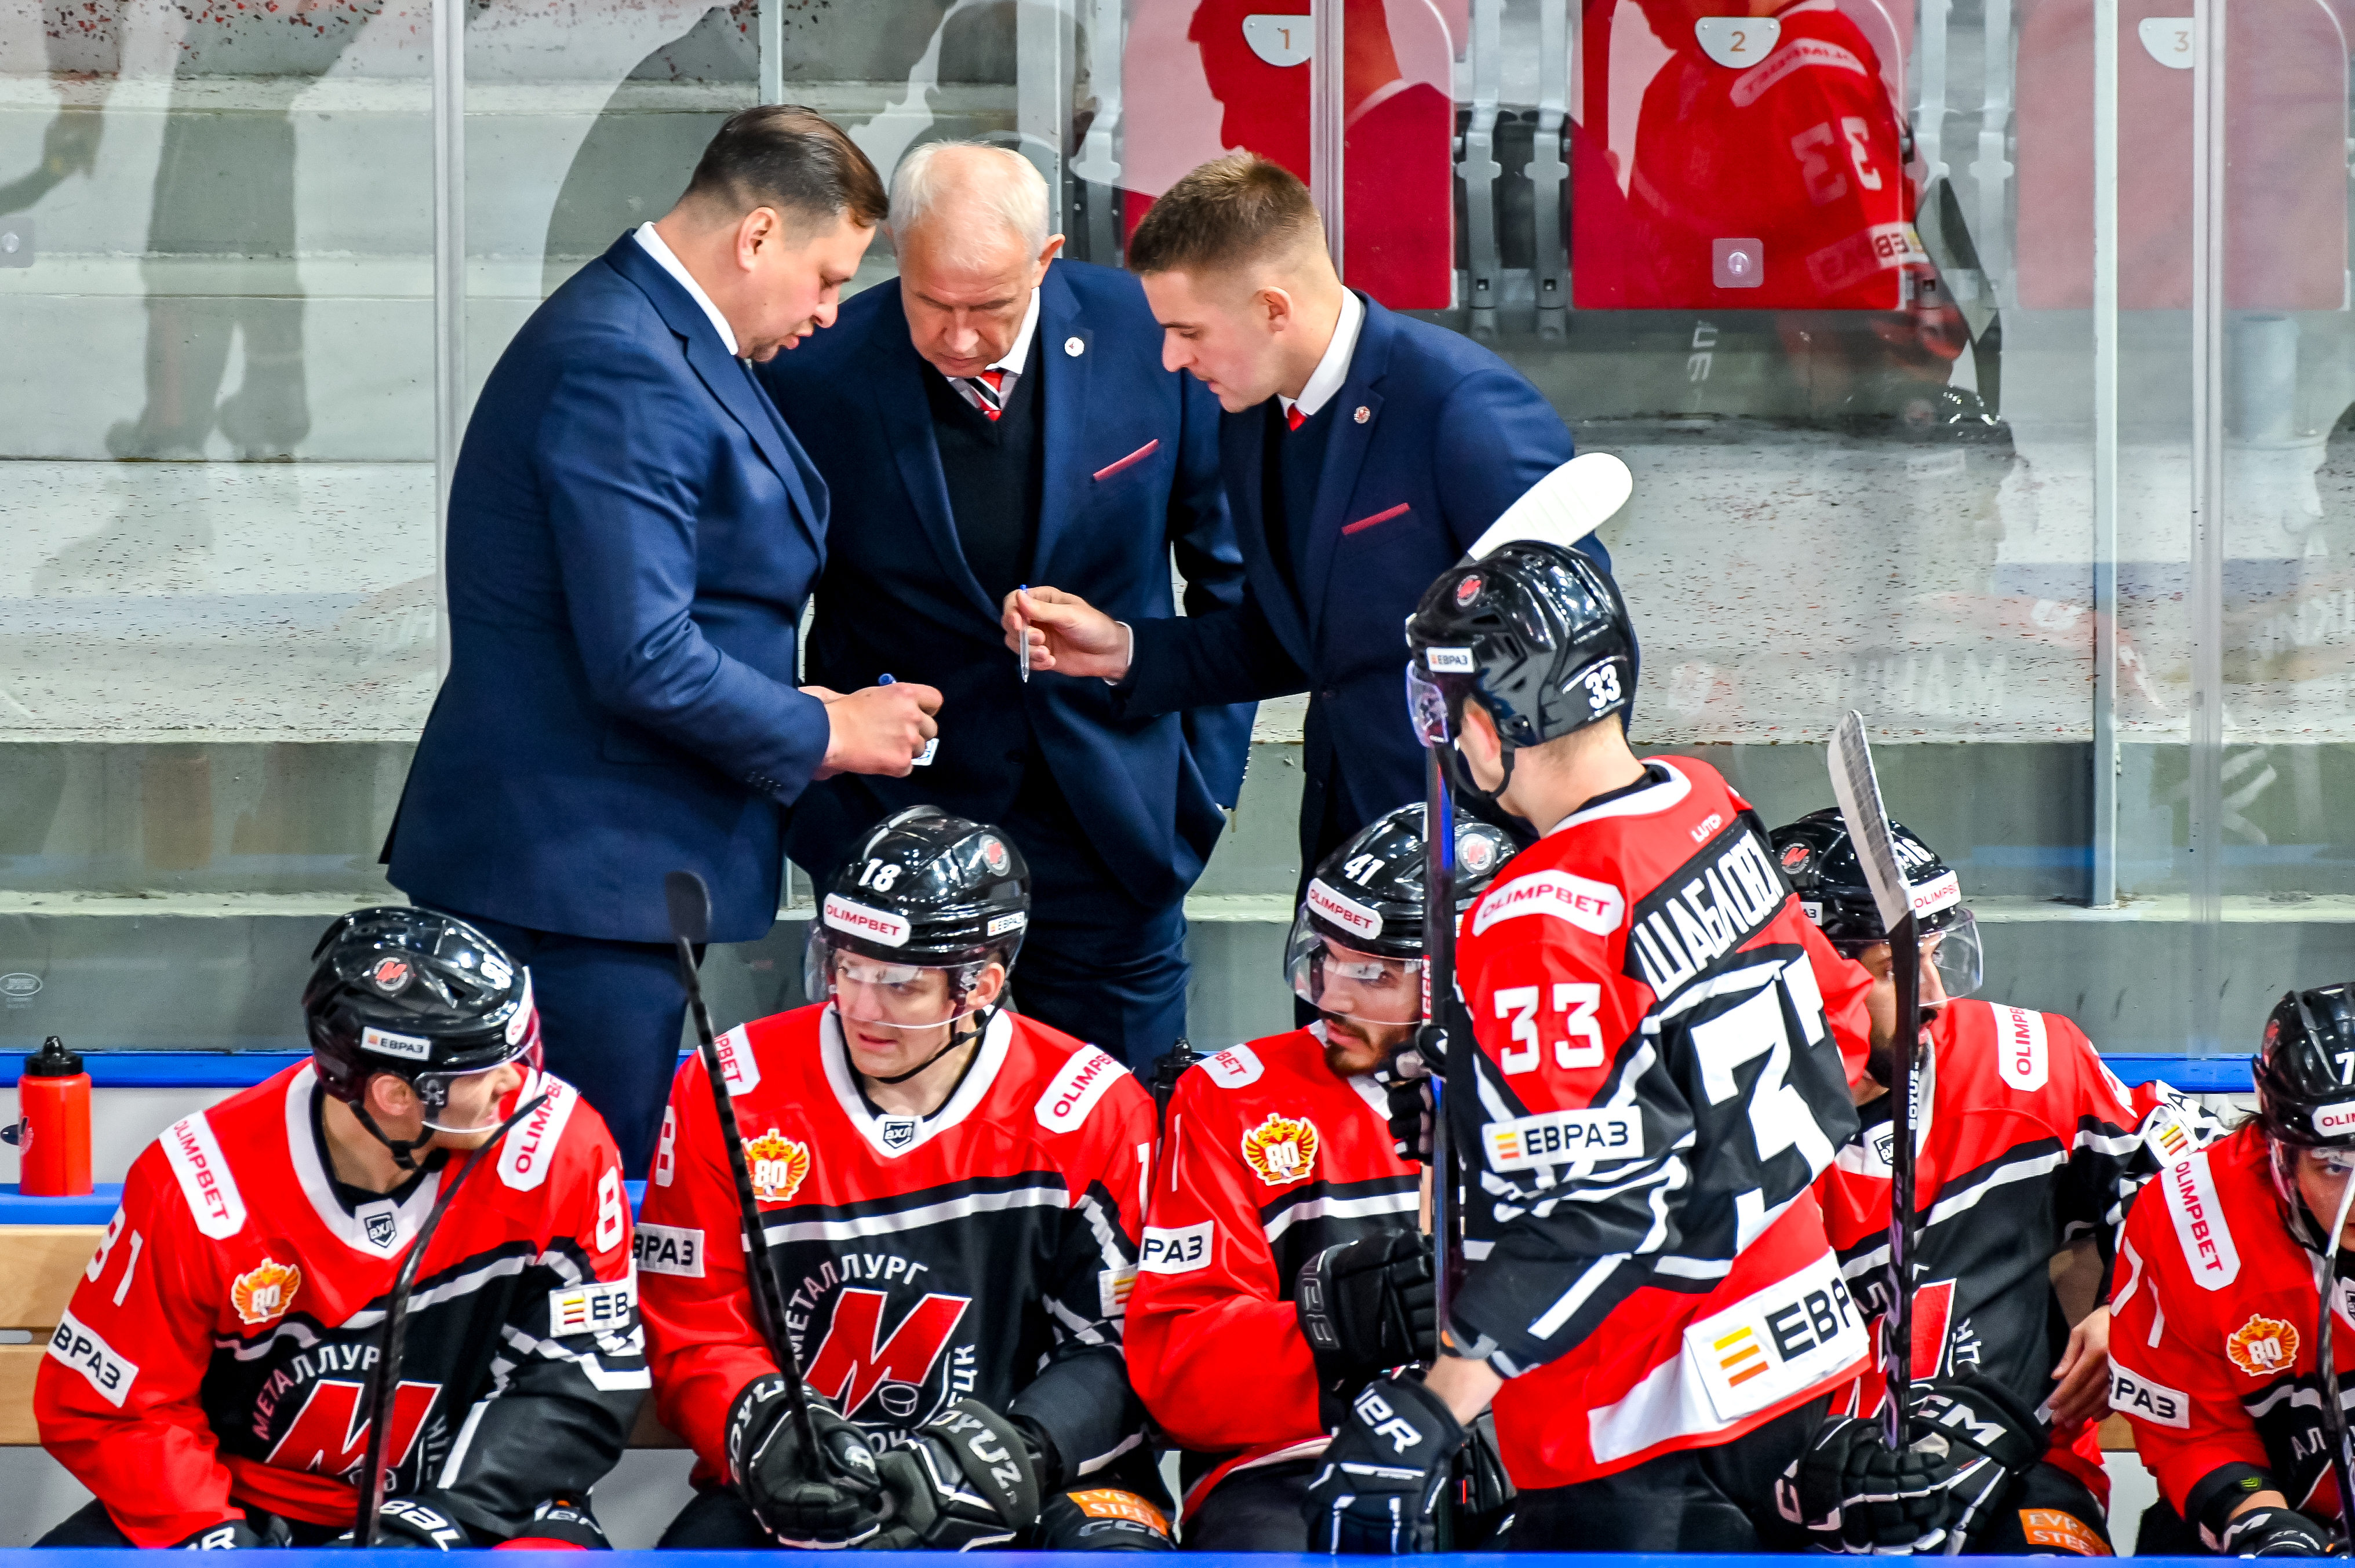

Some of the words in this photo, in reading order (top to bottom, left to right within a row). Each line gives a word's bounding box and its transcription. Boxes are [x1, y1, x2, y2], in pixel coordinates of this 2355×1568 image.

[1281, 28, 1291, 49] 1
[1730, 31, 1746, 52] 2
[2174, 31, 2189, 53] 3
[1585, 664, 1622, 709] 33
[858, 858, 902, 892] 18
[1344, 854, 1385, 886] 41
[1309, 888, 1374, 929] OLIMPBET
[1482, 884, 1611, 919] OLIMPBET
[825, 904, 901, 937] OLIMPBET
[380, 1037, 424, 1054] ЕВРАЗ
[1494, 982, 1605, 1075] 33
[2010, 1007, 2032, 1075] OLIMPB
[1053, 1052, 1117, 1117] OLIMPB
[2335, 1051, 2355, 1085] 7
[655, 1105, 676, 1187] 8
[1524, 1120, 1629, 1157] ЕВРАЗ
[174, 1120, 230, 1220] OLIMPBET
[754, 1159, 788, 1189] 80
[1265, 1142, 1301, 1173] 80
[596, 1165, 623, 1254] 8
[2174, 1161, 2225, 1272] OLIMPBET
[632, 1234, 694, 1266] ВРАЗ
[1143, 1235, 1203, 1264] РАЗ
[785, 1253, 929, 1361] МЕТАЛЛУРГ
[1766, 1276, 1852, 1363] ЕВР
[53, 1322, 121, 1390] ВРАЗ
[2247, 1336, 2283, 1365] 80
[252, 1344, 381, 1442] МЕТАЛЛУР
[2115, 1376, 2176, 1419] РАЗ
